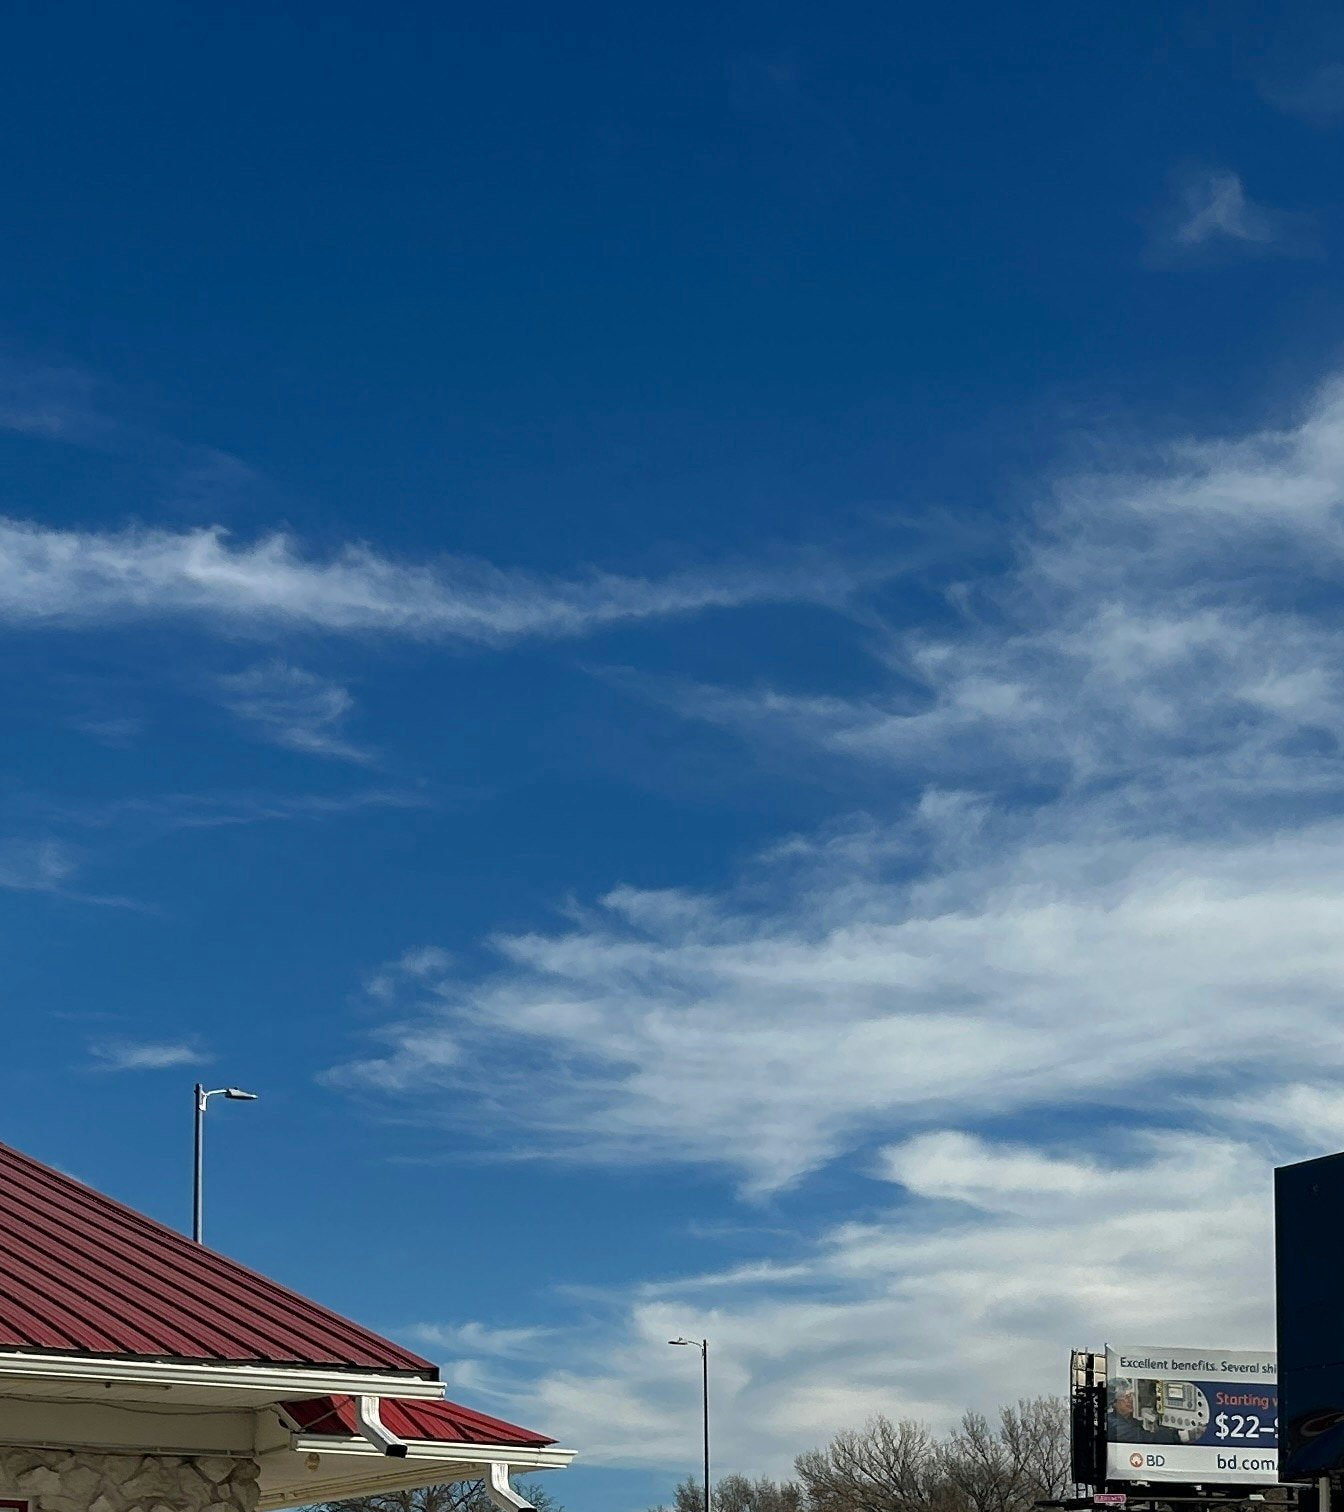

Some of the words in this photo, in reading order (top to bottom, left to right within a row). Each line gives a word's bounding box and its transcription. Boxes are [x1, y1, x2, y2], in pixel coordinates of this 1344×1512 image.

[1120, 1356, 1168, 1370] Excellent
[1171, 1359, 1218, 1372] benefits.
[1221, 1361, 1259, 1373] Several
[1216, 1391, 1269, 1410] Starting
[1146, 1455, 1165, 1467] BD
[1217, 1453, 1278, 1471] bd.com
